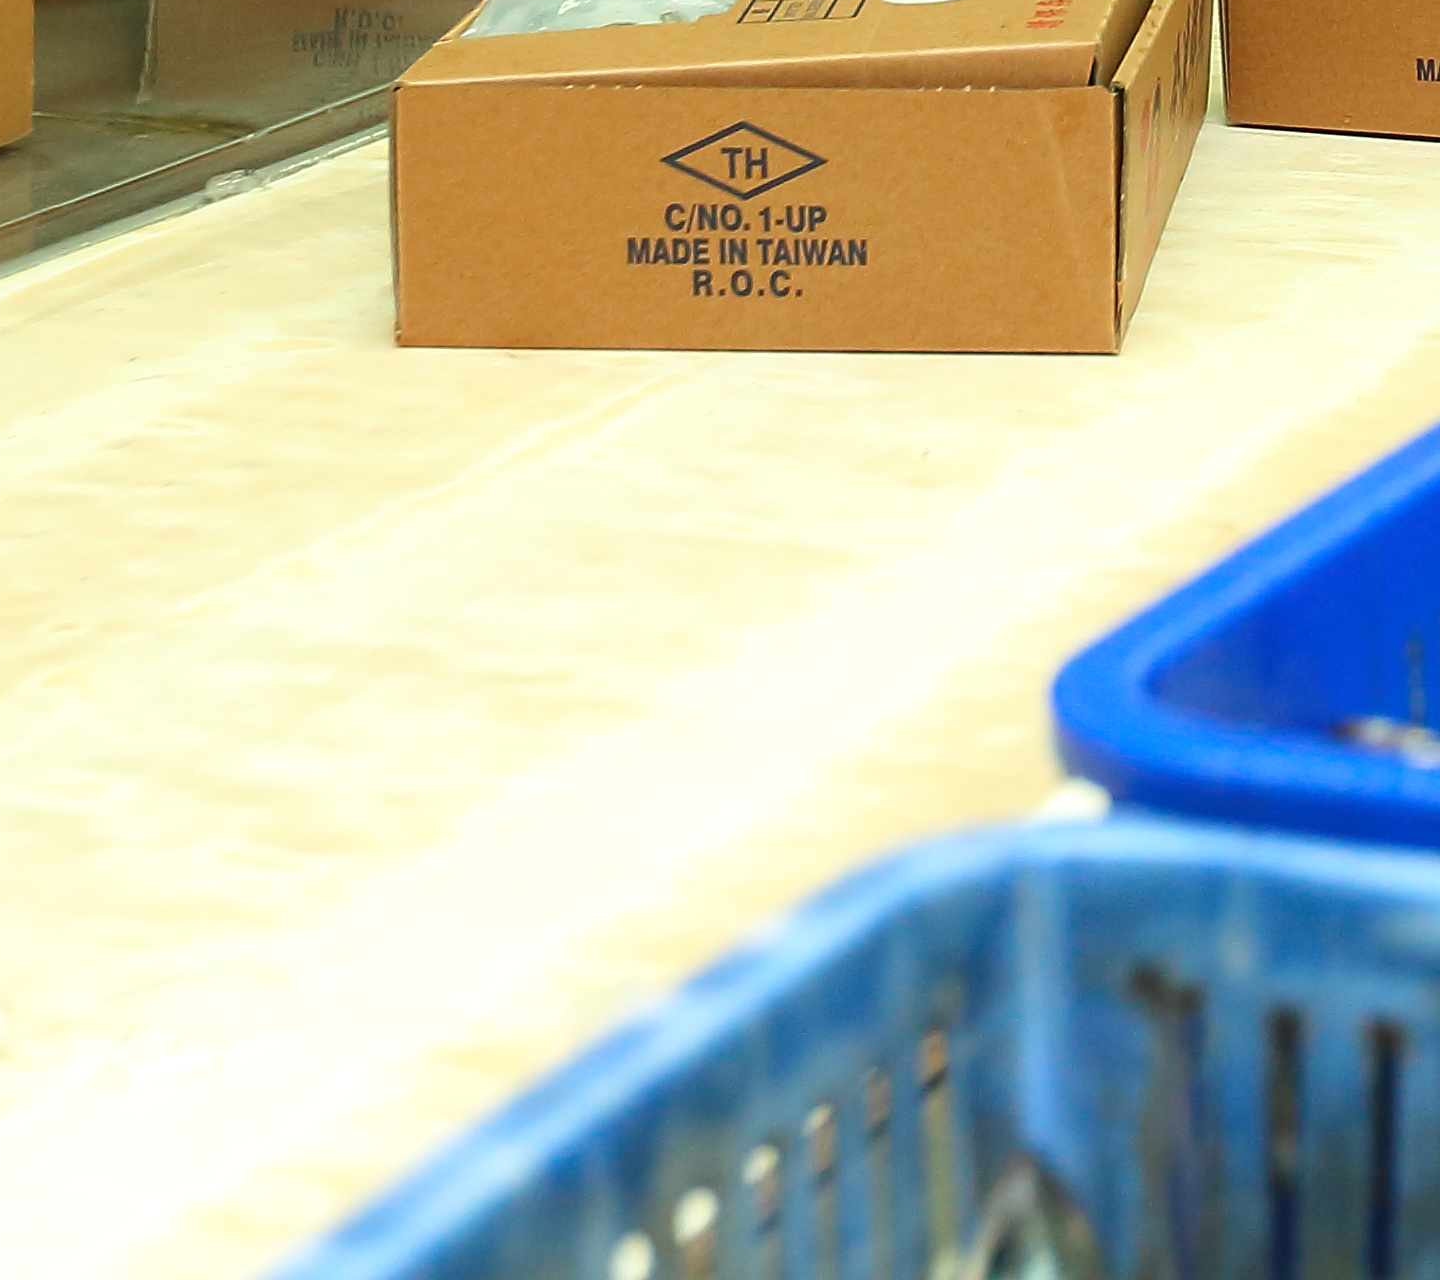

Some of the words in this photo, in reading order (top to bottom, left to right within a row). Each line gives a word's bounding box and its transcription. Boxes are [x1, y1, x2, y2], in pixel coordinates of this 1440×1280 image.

[721, 148, 768, 179] TH
[664, 204, 751, 233] C/NO.
[759, 205, 827, 233] 1-UP
[626, 237, 711, 266] MADE
[718, 237, 748, 266] IN
[755, 238, 868, 267] TAIWAN
[692, 269, 803, 298] R.O.C.
